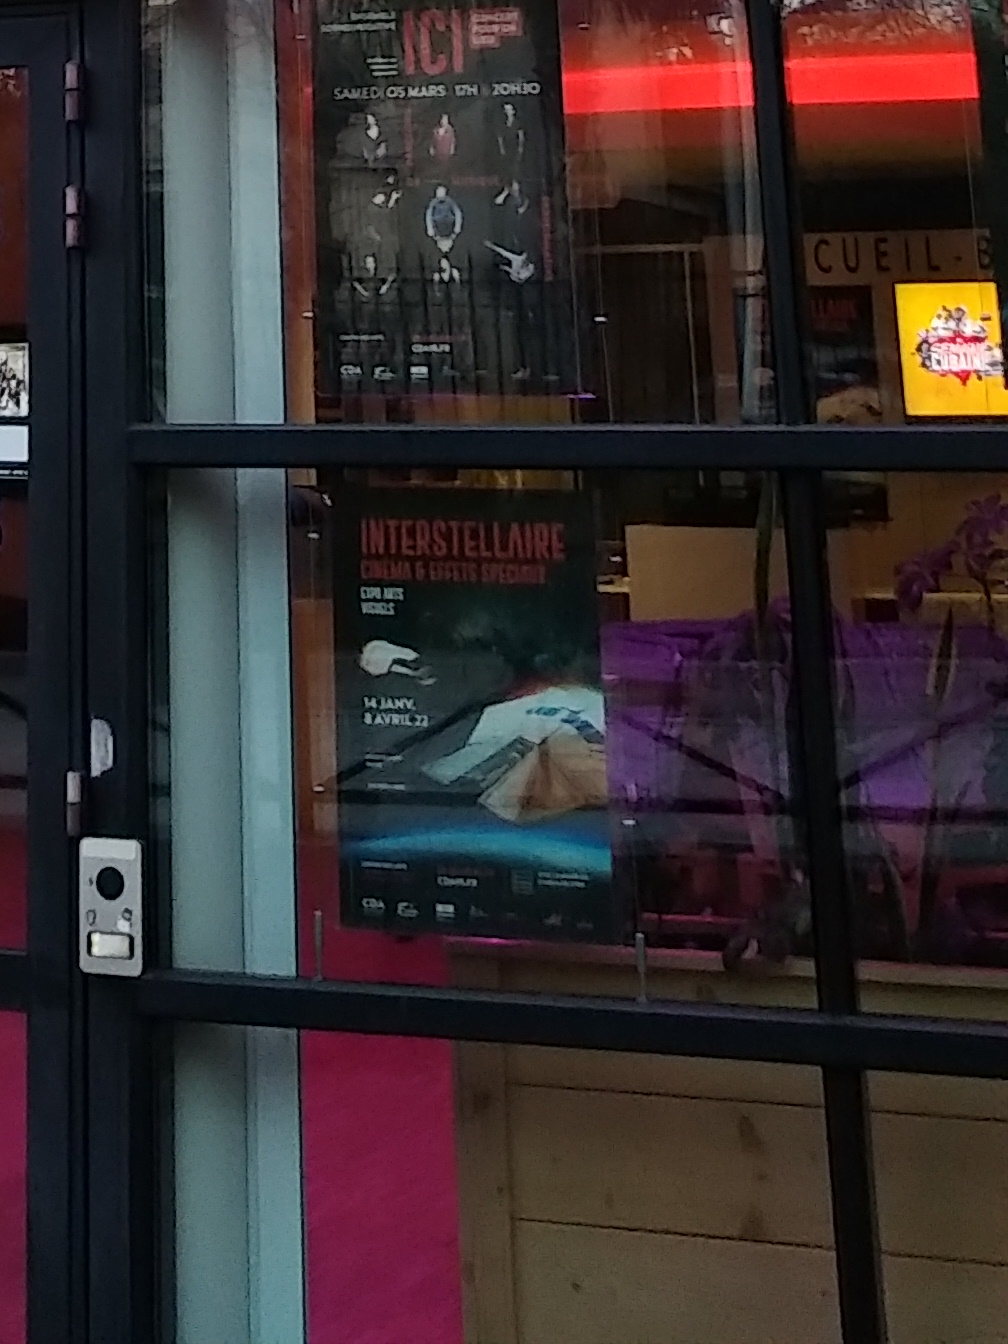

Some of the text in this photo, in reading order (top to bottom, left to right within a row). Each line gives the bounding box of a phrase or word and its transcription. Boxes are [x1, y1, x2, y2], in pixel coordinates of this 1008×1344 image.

[402, 8, 464, 75] ICI
[333, 86, 382, 100] SAMEDI
[386, 85, 406, 98] 05
[407, 84, 447, 98] MARS
[361, 518, 566, 560] INTERSTELLAIRE
[363, 696, 416, 711] 14 JANV.
[363, 712, 373, 725] 8
[374, 713, 412, 726] AVRIL
